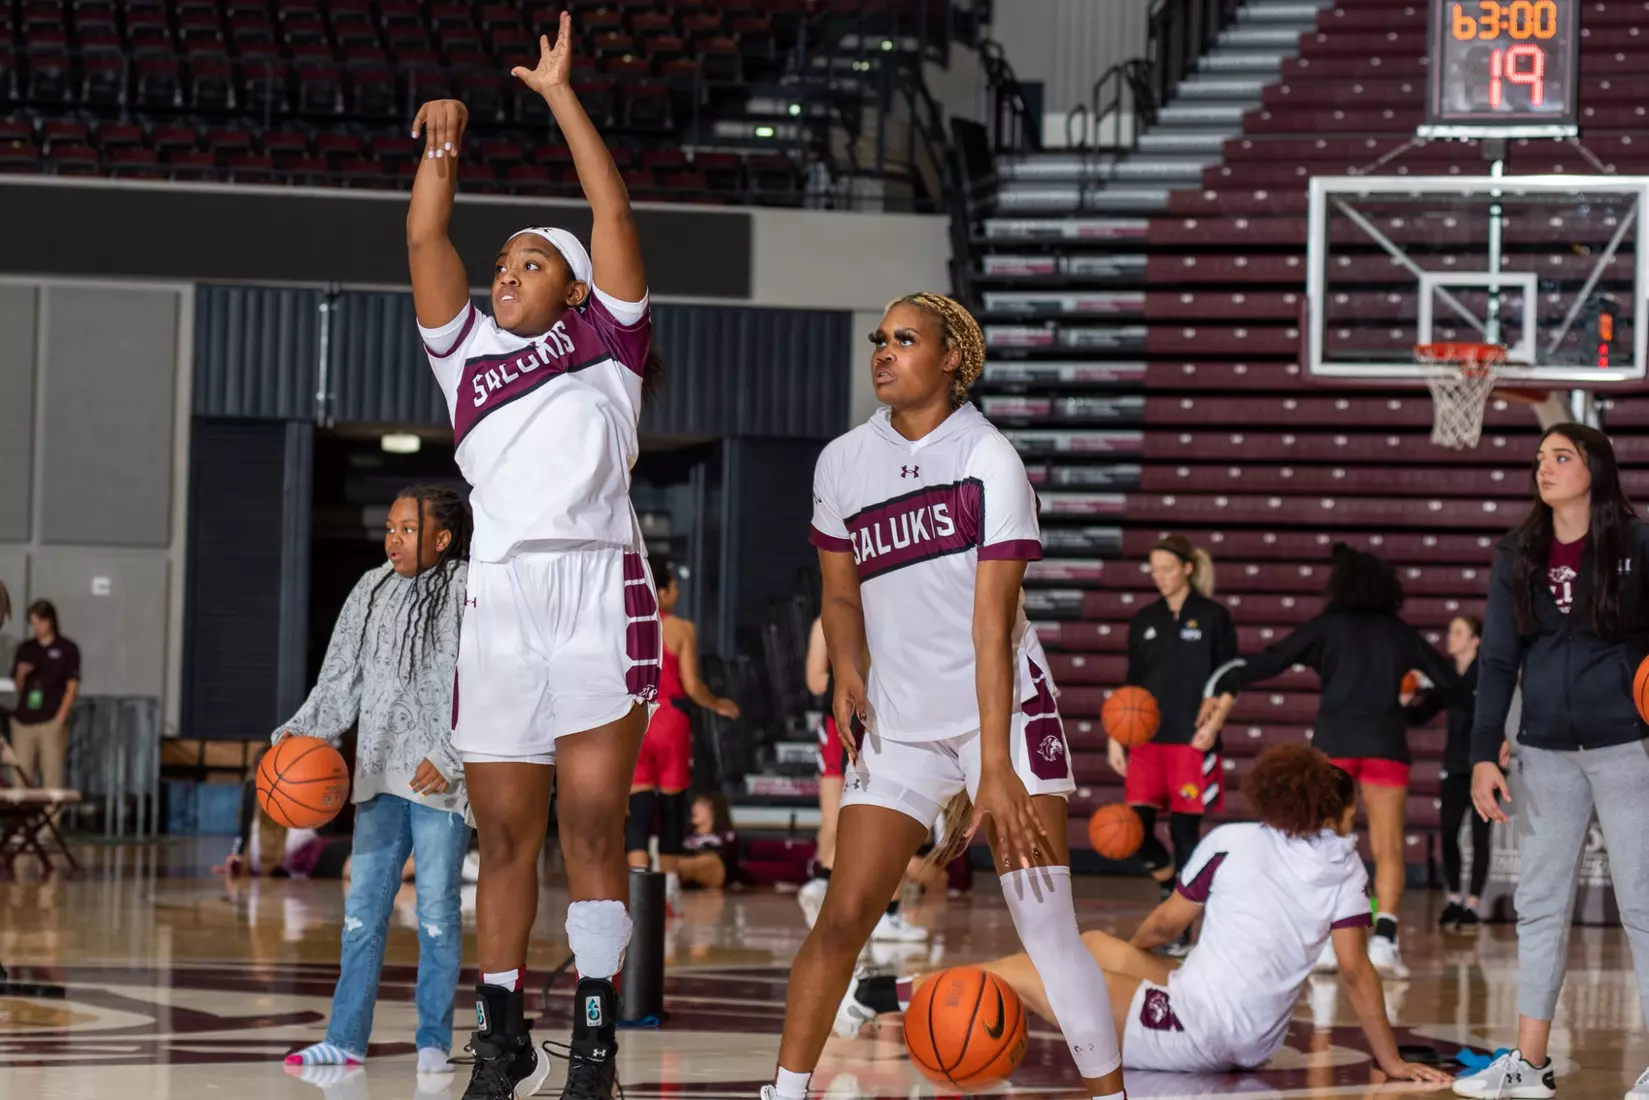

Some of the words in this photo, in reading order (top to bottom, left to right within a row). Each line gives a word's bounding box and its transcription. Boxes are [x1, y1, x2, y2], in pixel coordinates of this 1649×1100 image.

[1452, 0, 1557, 40] 63:00
[1489, 44, 1545, 109] 19
[849, 503, 956, 566] SALUKIS
